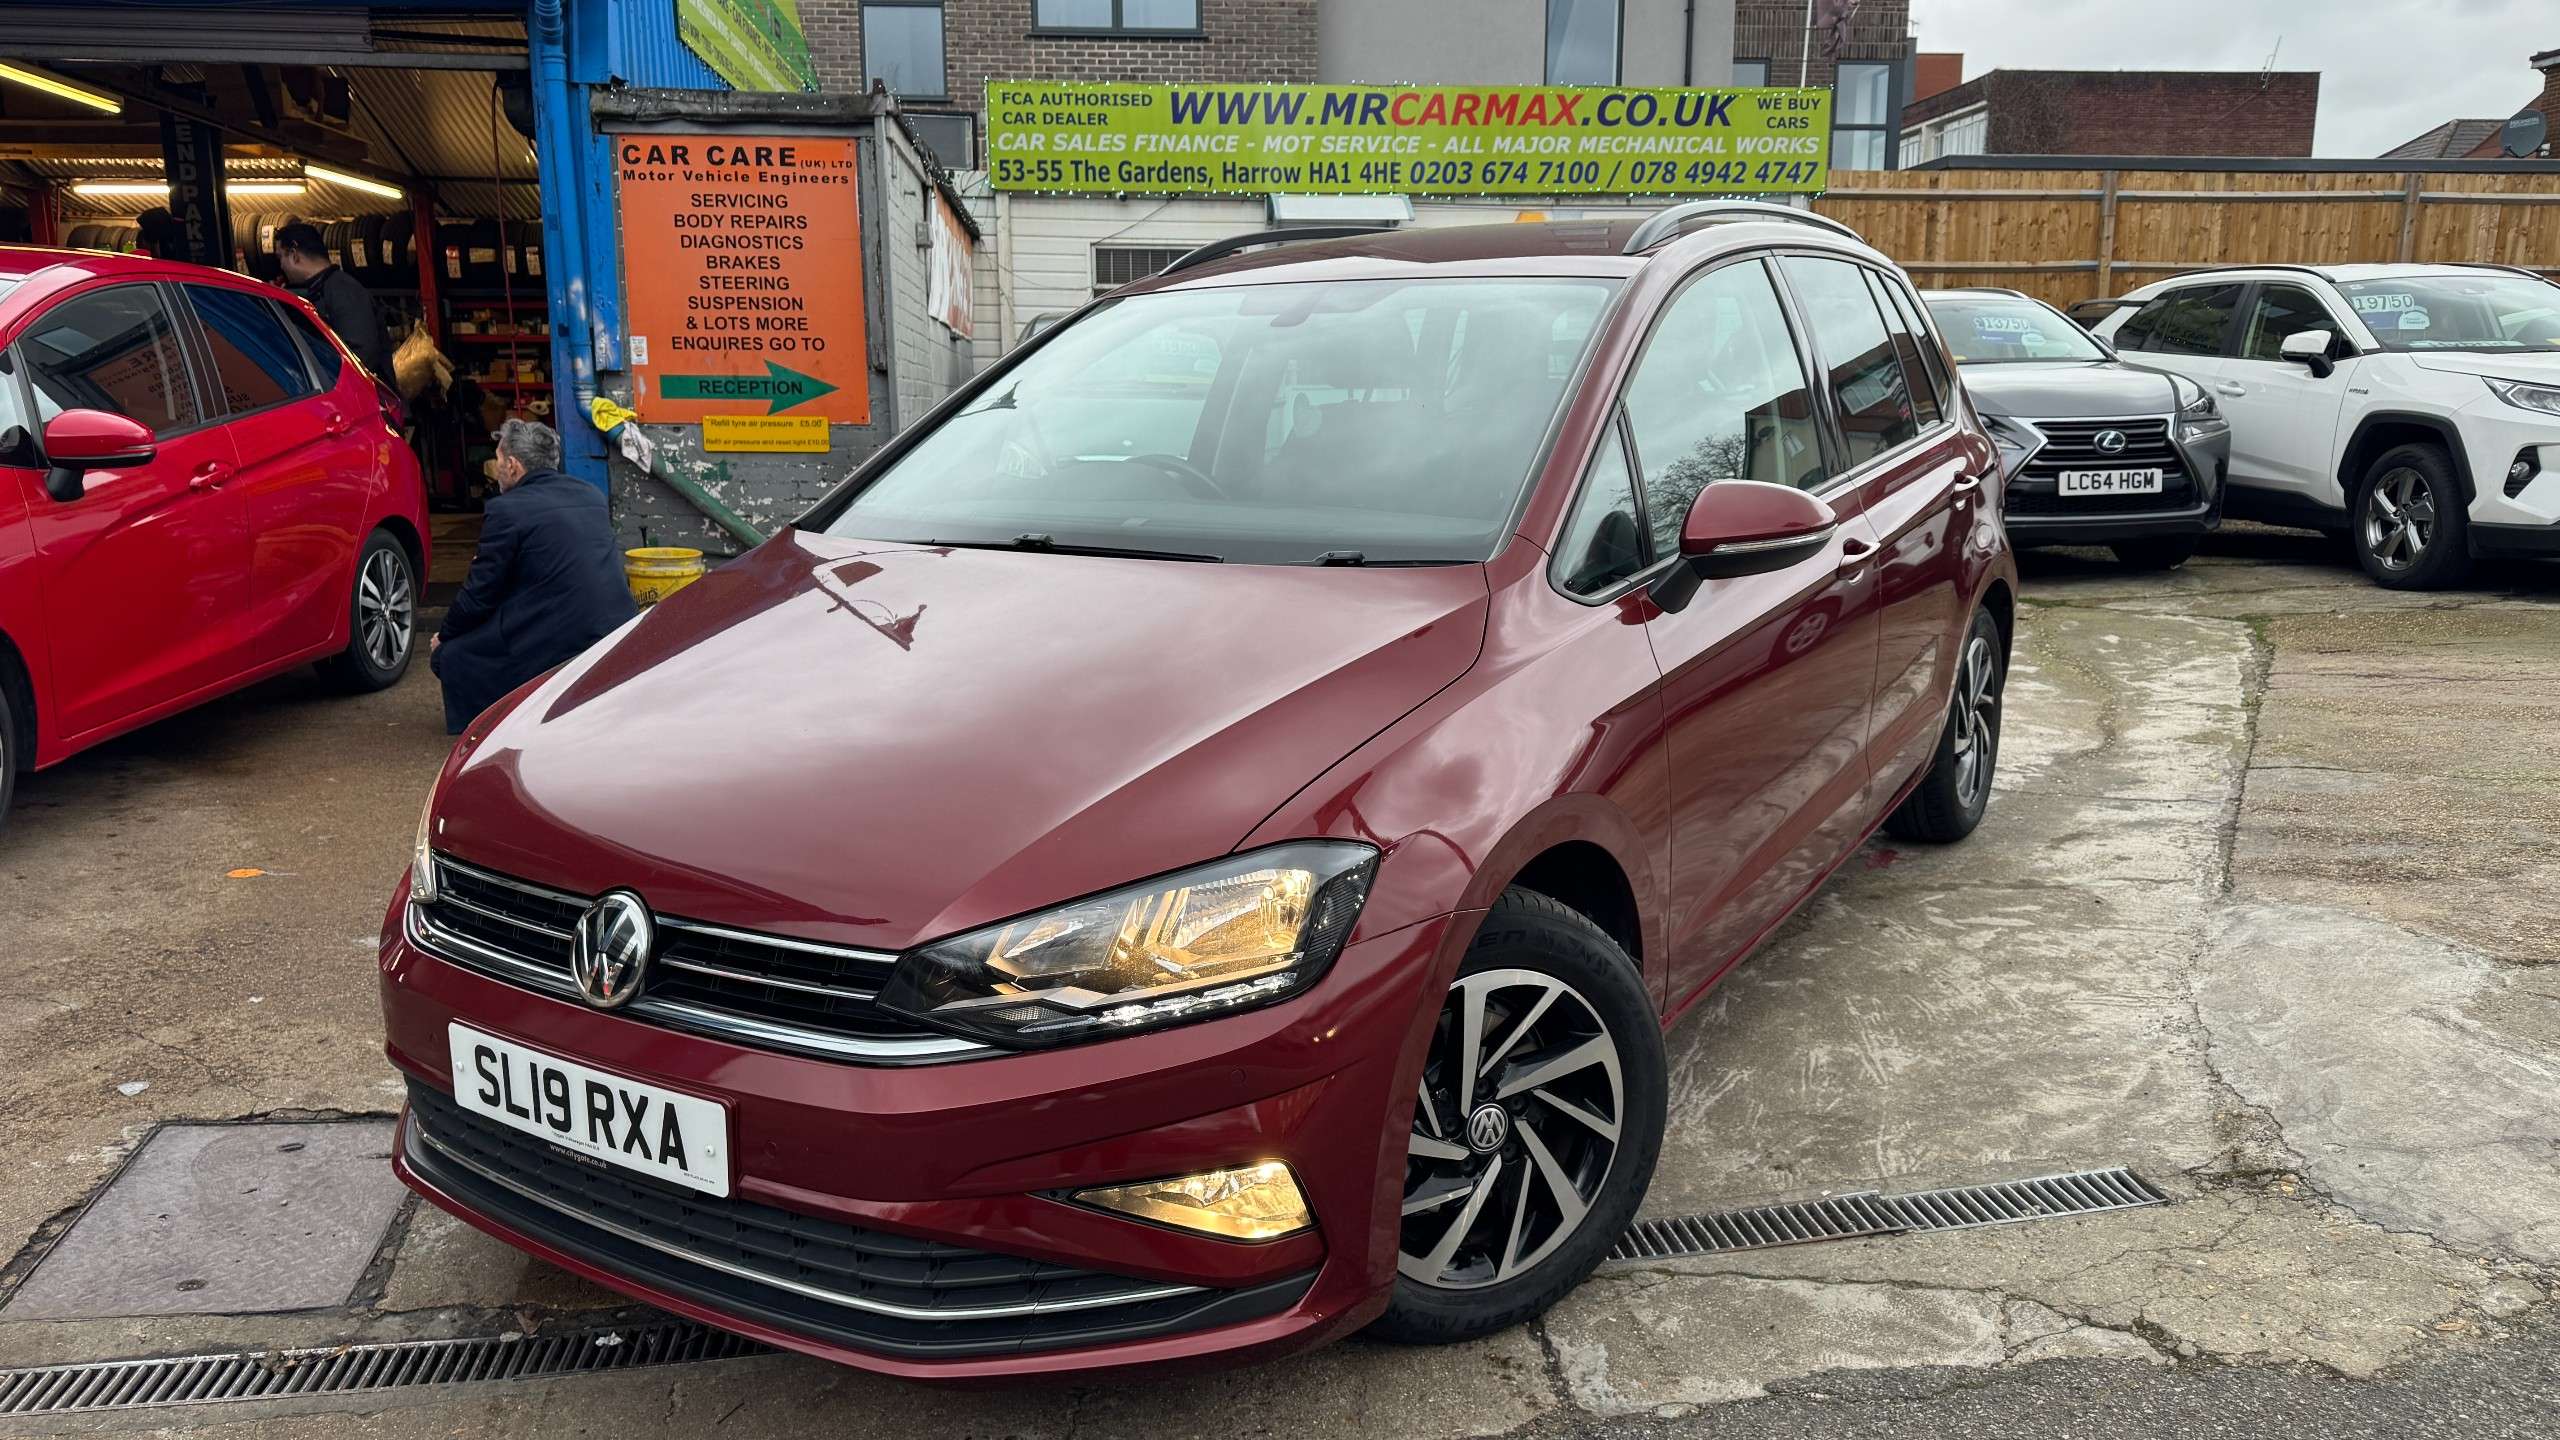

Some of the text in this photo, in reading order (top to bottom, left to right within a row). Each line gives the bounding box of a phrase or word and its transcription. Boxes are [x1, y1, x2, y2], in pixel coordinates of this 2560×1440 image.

[1001, 92, 1152, 107] FCA AUTHORISED
[1757, 97, 1821, 111] WE BUY
[1002, 111, 1109, 126] CAR DEALER
[1766, 116, 1809, 130] CARS
[998, 132, 1045, 152] CAR
[1052, 133, 1129, 153] SALES
[1133, 134, 1238, 154] FINANCE
[1262, 135, 1316, 154] MOT
[1320, 135, 1419, 154] SERVICE
[1442, 136, 1484, 154] ALL
[1498, 136, 1572, 155] MAJOR
[1579, 136, 1728, 155] MECHANICAL
[1735, 136, 1820, 155] WORKS
[623, 144, 853, 169] CAR CARE (UK) LTD
[623, 169, 849, 186] Motor Vehicle Engineers
[999, 160, 1820, 187] 53-55 The Gardens, Harrow HA1 4HE 0203 674 7100 / 078 4942 4747
[691, 193, 788, 209] SERVICING
[674, 214, 808, 230] BODY REPAIRS
[680, 234, 804, 250] DIAGNOSTICS
[706, 255, 781, 270] BRAKES
[699, 275, 790, 291] STEERING
[688, 296, 804, 311] SUSPENSION
[686, 316, 808, 331] & LOTS MORE
[672, 336, 825, 352] ENQUIRES GO TO
[699, 379, 803, 395] RECEPTION
[760, 420, 794, 430] pressure
[2067, 471, 2154, 491] LC64 HGM
[474, 1044, 690, 1172] SL19 RXA
